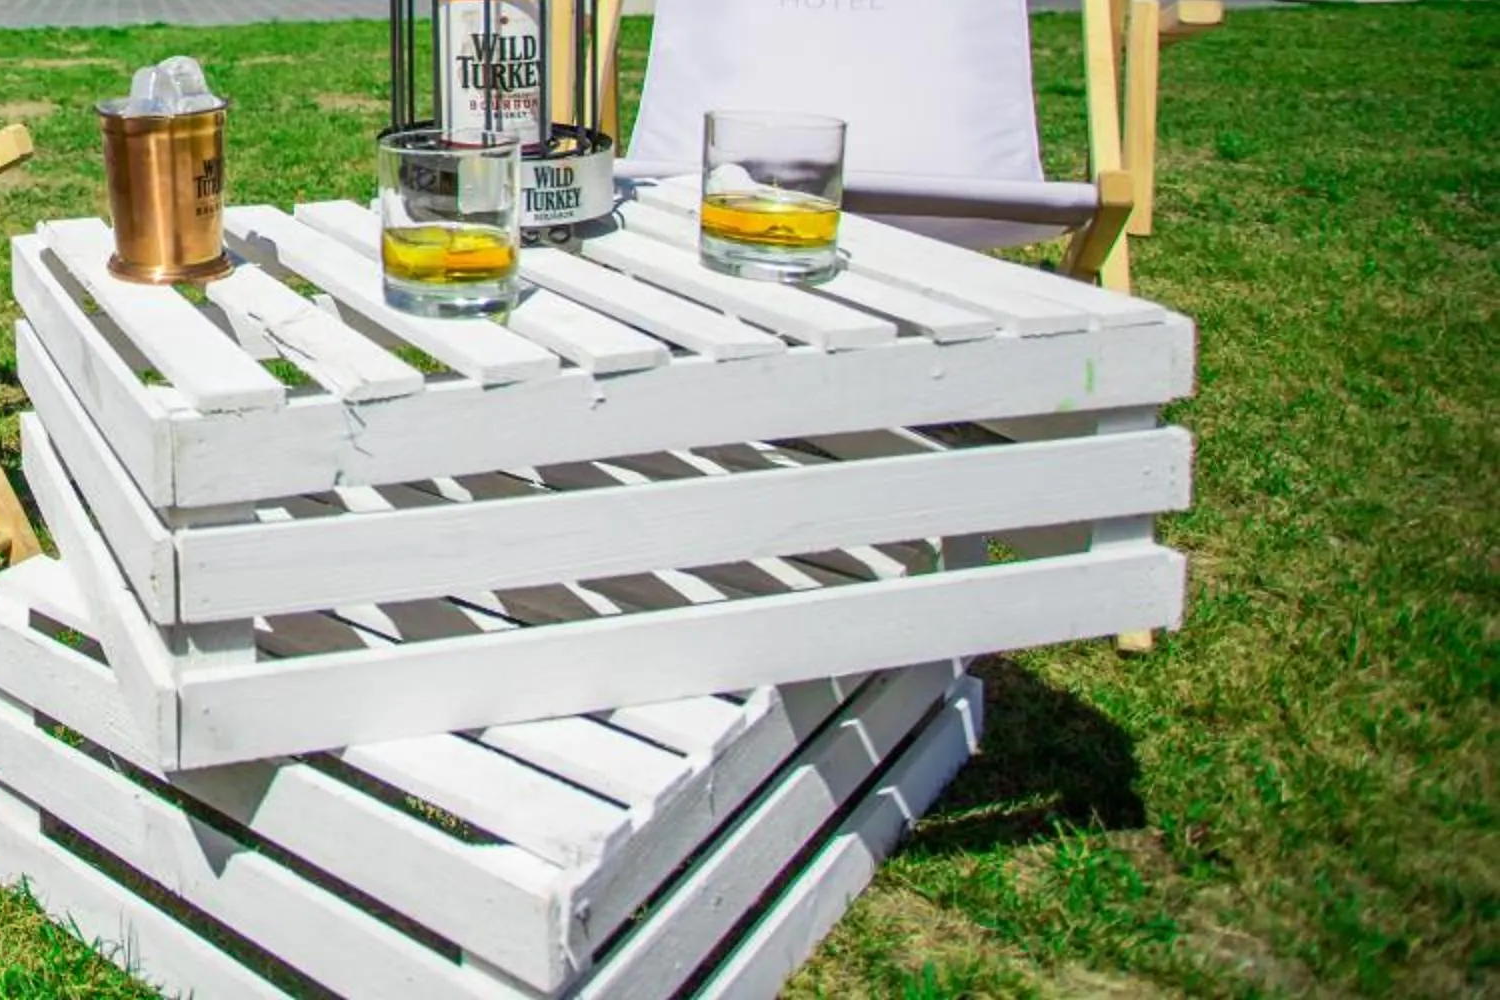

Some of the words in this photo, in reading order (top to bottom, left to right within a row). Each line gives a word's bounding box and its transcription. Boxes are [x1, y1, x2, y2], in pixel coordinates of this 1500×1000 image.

[470, 33, 537, 62] WILD
[533, 166, 574, 188] WILD
[521, 186, 581, 213] TURKEY
